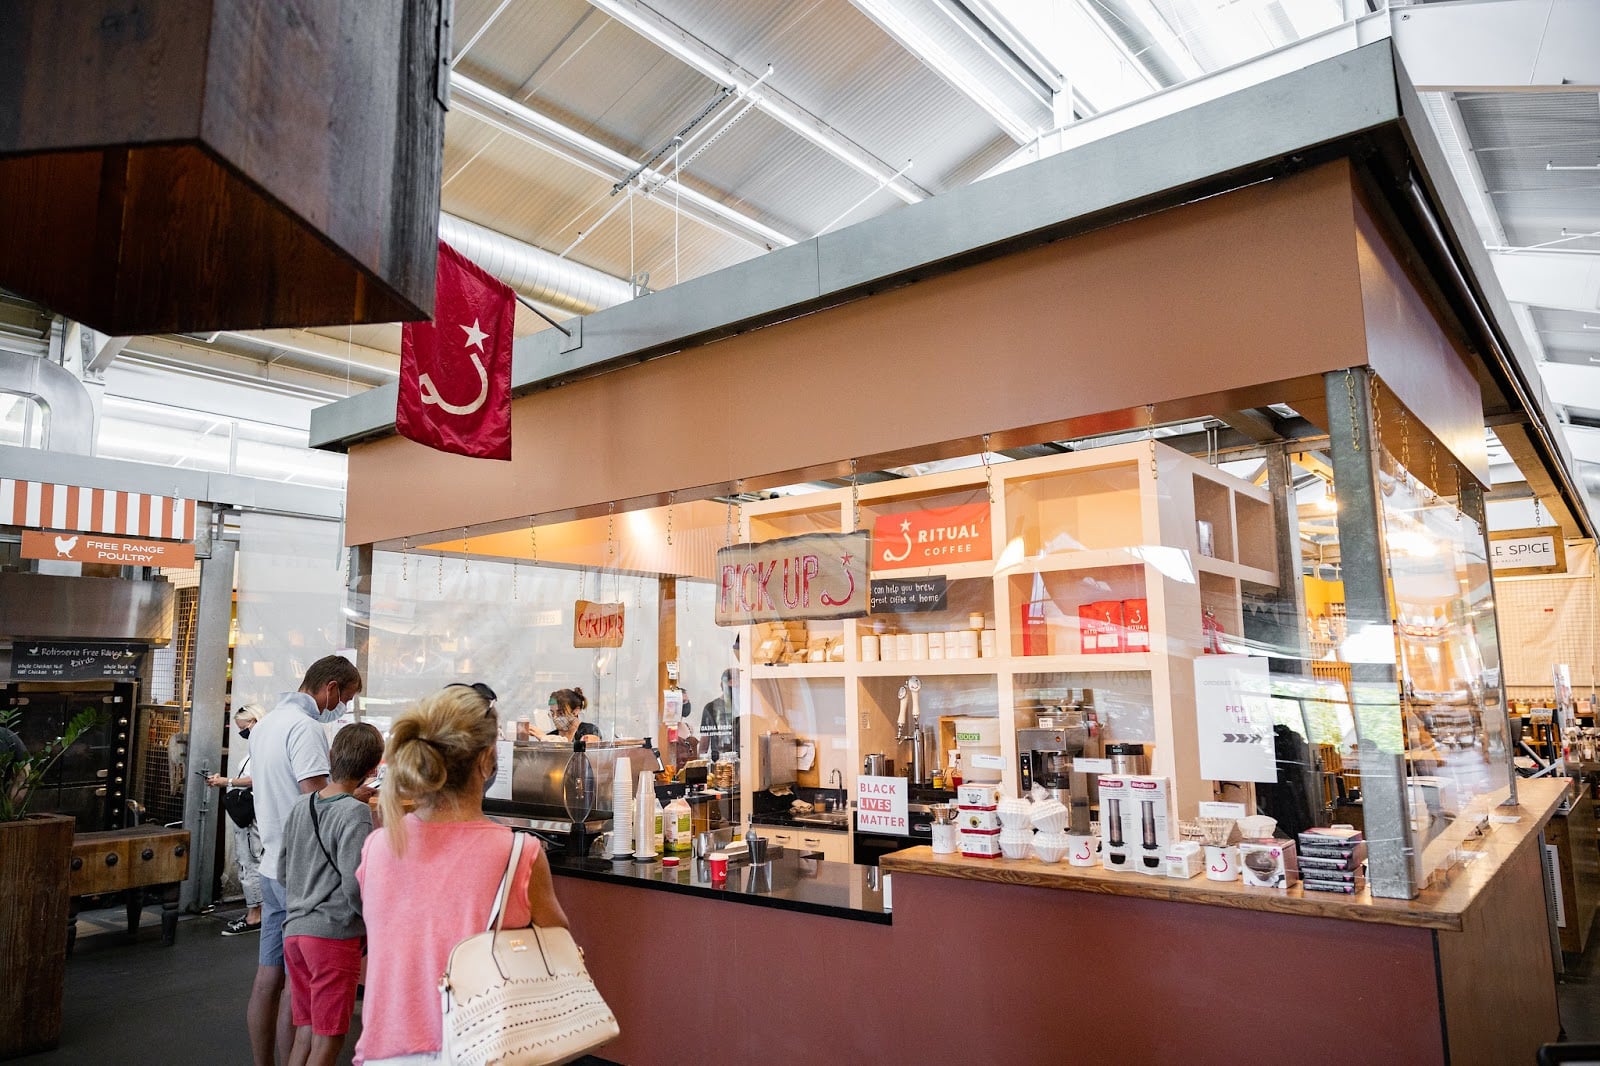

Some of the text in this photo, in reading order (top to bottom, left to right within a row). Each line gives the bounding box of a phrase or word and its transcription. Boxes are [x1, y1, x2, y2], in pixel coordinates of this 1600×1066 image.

[918, 524, 979, 543] RITUAL
[86, 541, 164, 554] FREE RANGE
[924, 544, 972, 556] COFFEE
[98, 551, 153, 562] POULTRY
[720, 554, 819, 613] PICK UP
[874, 586, 884, 594] can
[885, 584, 899, 594] help
[901, 585, 913, 594] you
[915, 583, 935, 592] brew
[870, 594, 939, 608] great coffee at home
[577, 613, 624, 638] ORDER
[82, 648, 99, 656] Free
[860, 783, 896, 794] BLACK
[860, 798, 891, 810] LIVES
[860, 814, 905, 827] MATTER
